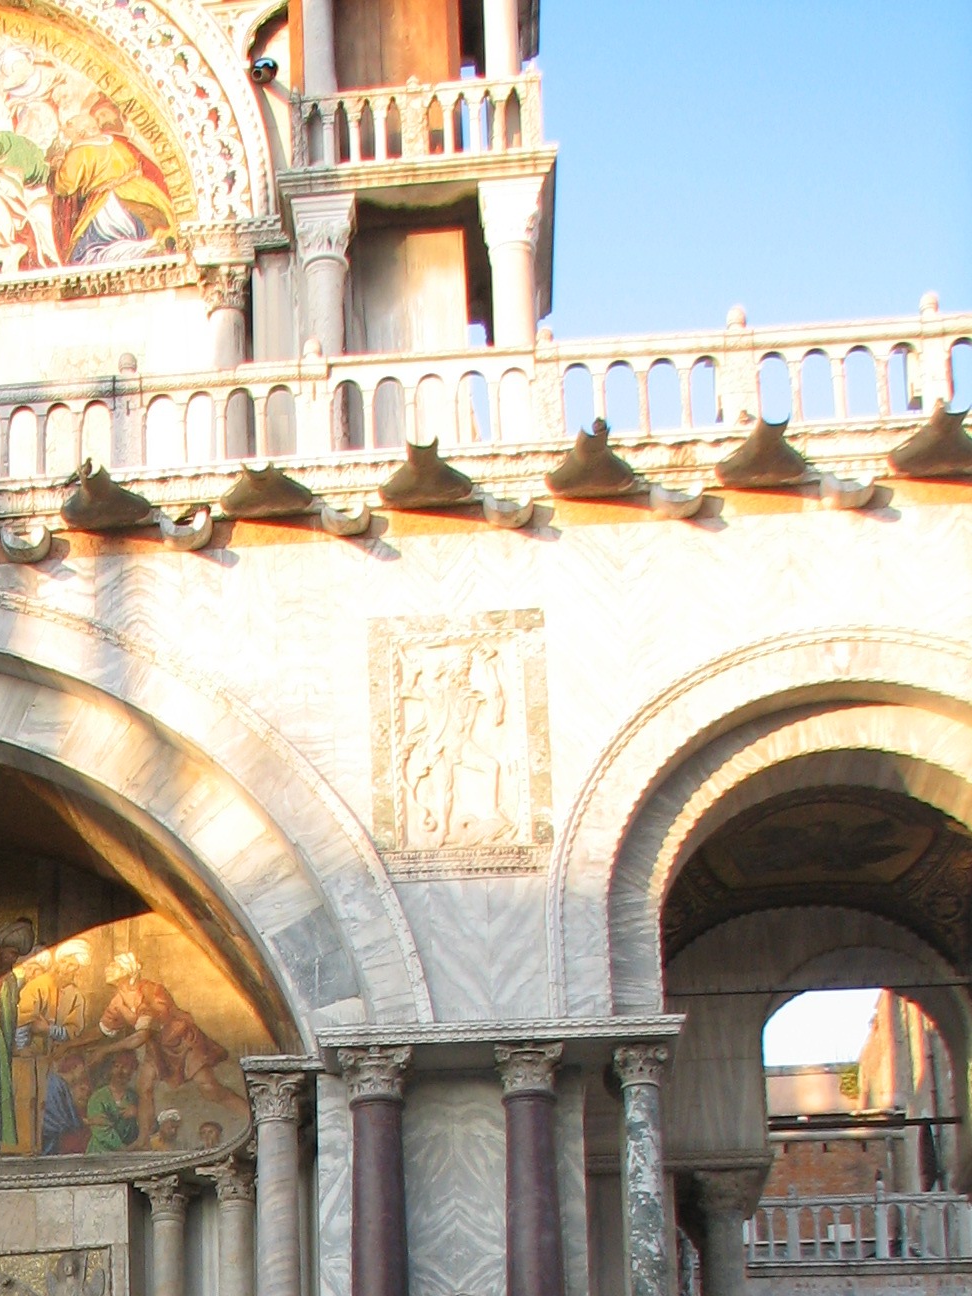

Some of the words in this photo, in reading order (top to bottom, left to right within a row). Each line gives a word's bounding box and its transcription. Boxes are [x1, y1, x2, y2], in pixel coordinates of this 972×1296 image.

[22, 26, 115, 92] ANGELICIS
[108, 82, 172, 157] LAVDIBVS
[158, 154, 184, 181] ET
